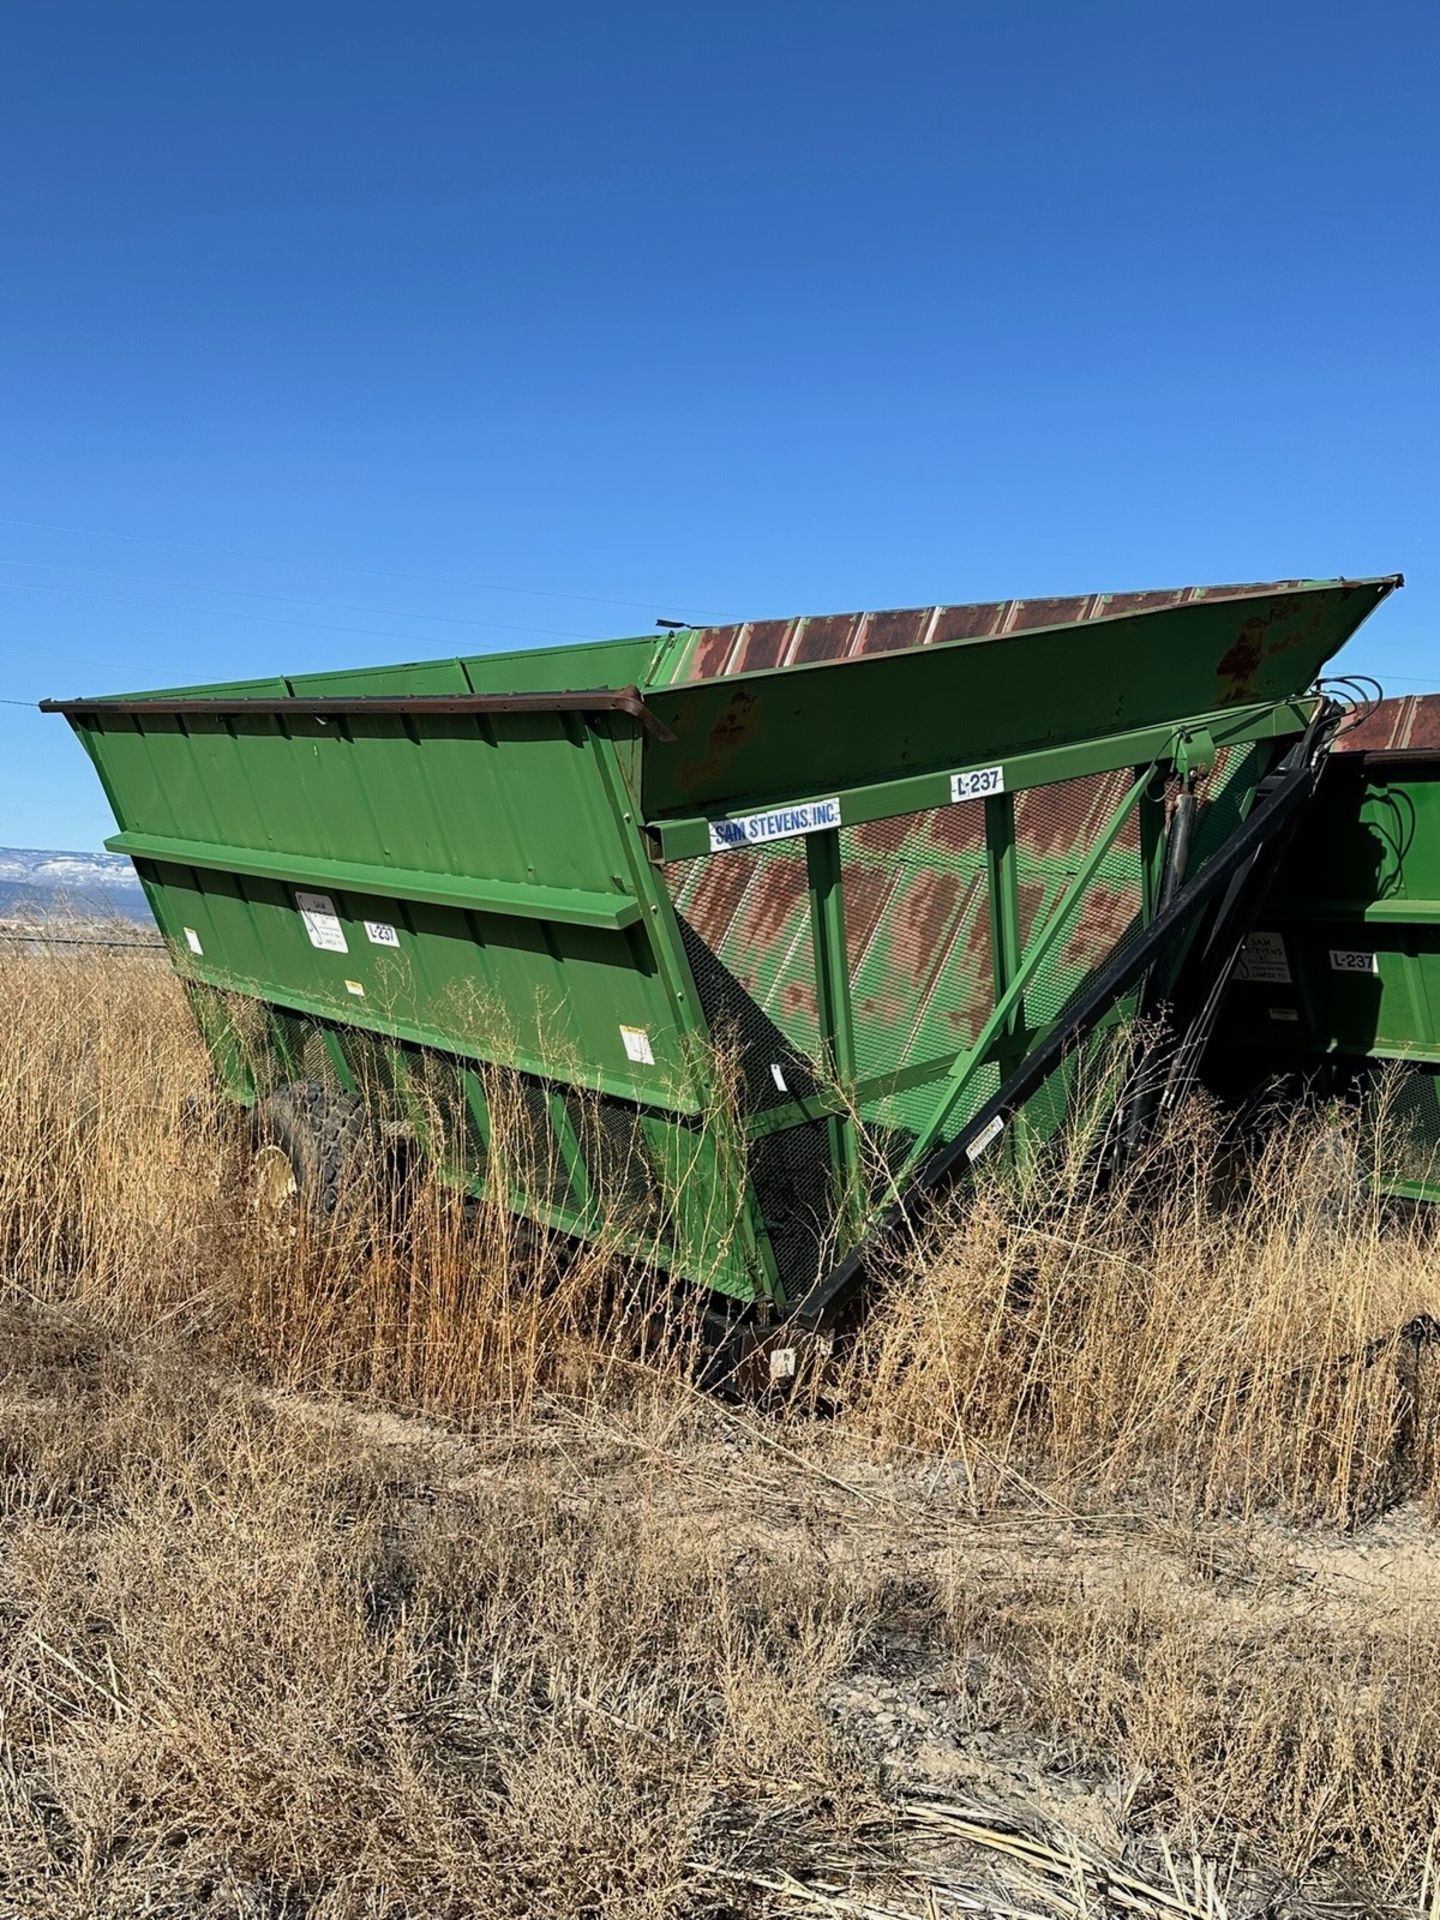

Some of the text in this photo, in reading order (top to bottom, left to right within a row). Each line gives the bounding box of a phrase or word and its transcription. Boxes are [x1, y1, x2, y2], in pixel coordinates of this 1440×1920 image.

[957, 771, 1000, 796] L-237
[715, 820, 747, 845] SAM
[1334, 953, 1373, 969] L-237
